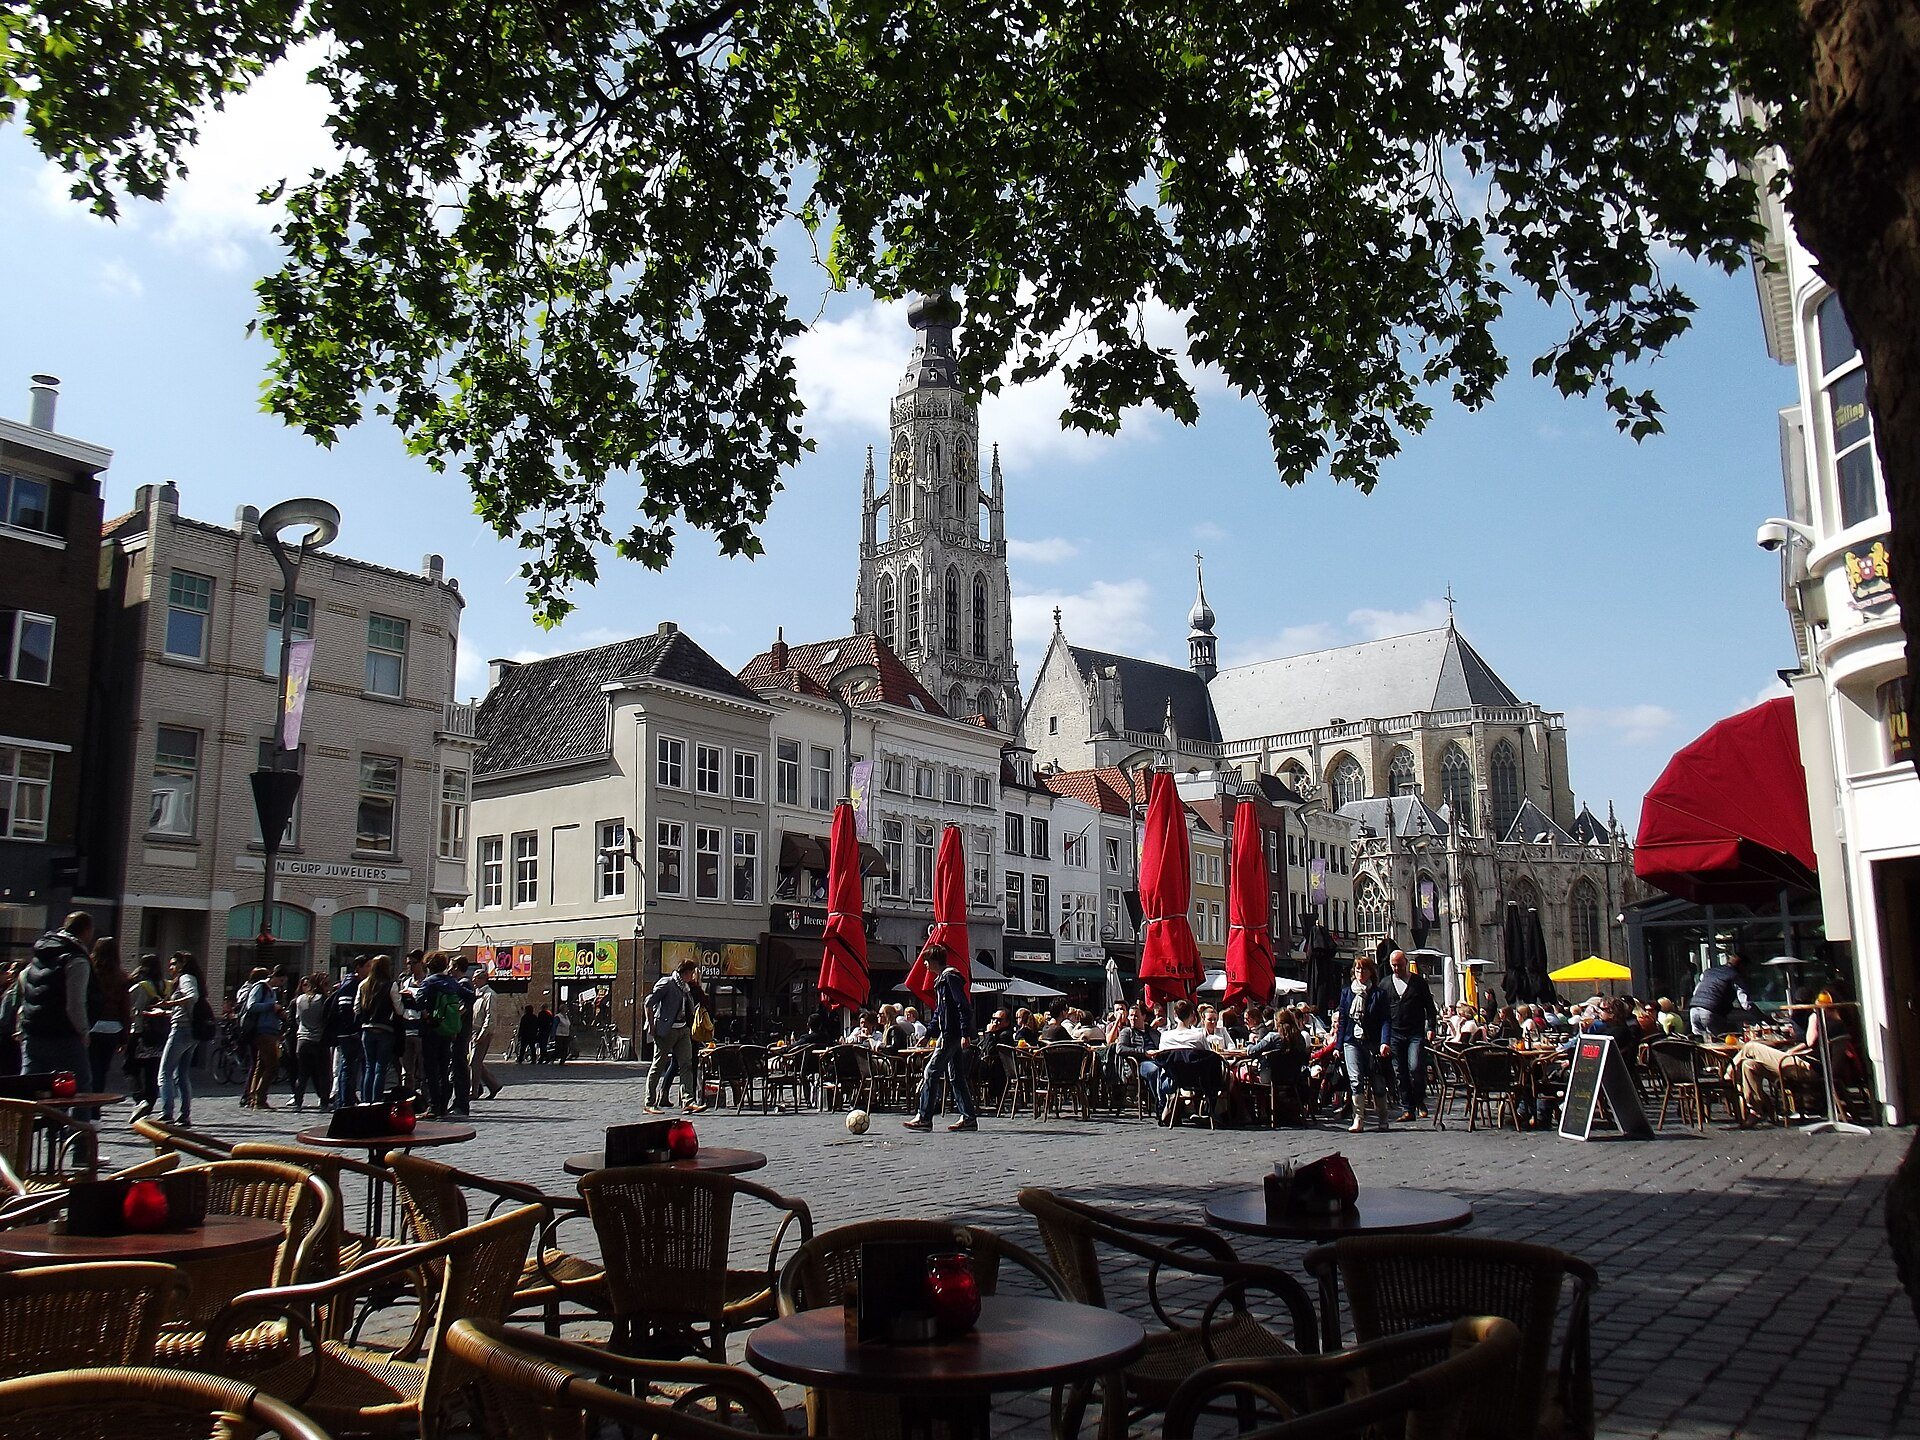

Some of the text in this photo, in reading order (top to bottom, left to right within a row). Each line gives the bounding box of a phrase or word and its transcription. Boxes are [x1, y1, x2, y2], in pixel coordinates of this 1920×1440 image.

[291, 862, 321, 874] GURP
[325, 864, 386, 880] JUWELIERS
[576, 949, 594, 966] GO
[702, 950, 720, 966] GO
[575, 965, 594, 976] Pasta
[701, 965, 720, 976] Pasta
